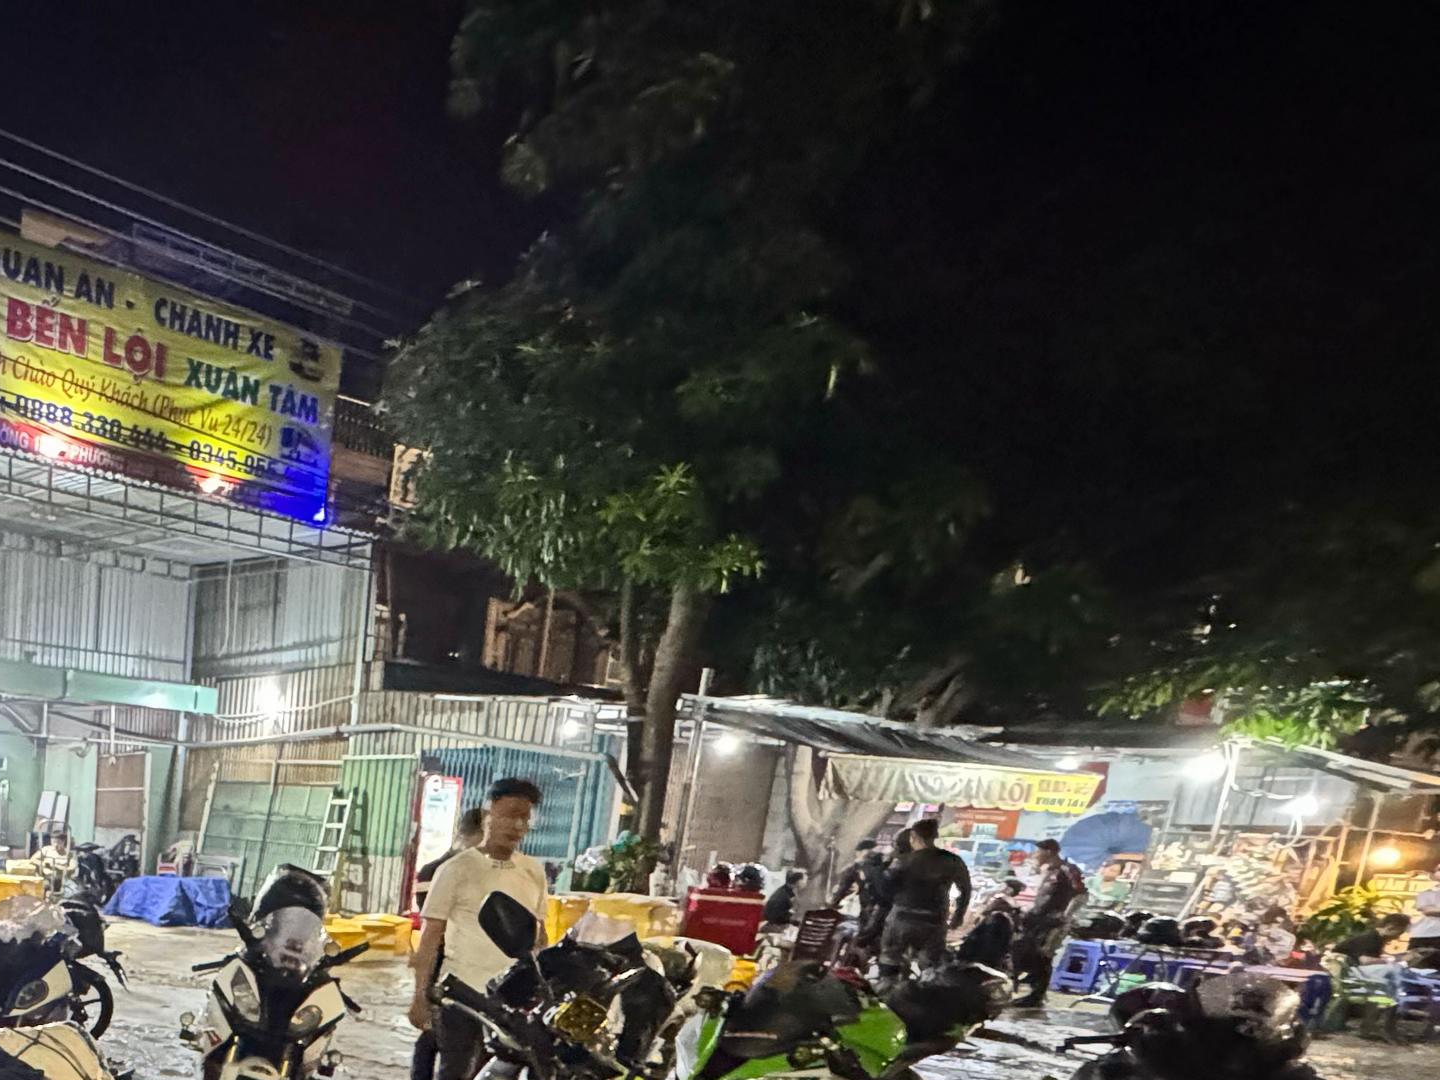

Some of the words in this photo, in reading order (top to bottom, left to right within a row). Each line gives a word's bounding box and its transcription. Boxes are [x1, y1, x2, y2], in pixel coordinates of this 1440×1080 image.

[6, 294, 89, 358] BẾN
[102, 326, 169, 385] LỘI
[247, 328, 276, 361] XE
[13, 354, 57, 390] Chào
[61, 367, 97, 402] Quý
[100, 377, 149, 409] Khách
[222, 413, 274, 450] 24/24)
[184, 357, 261, 407] XUÂN
[268, 384, 321, 424] TÂM
